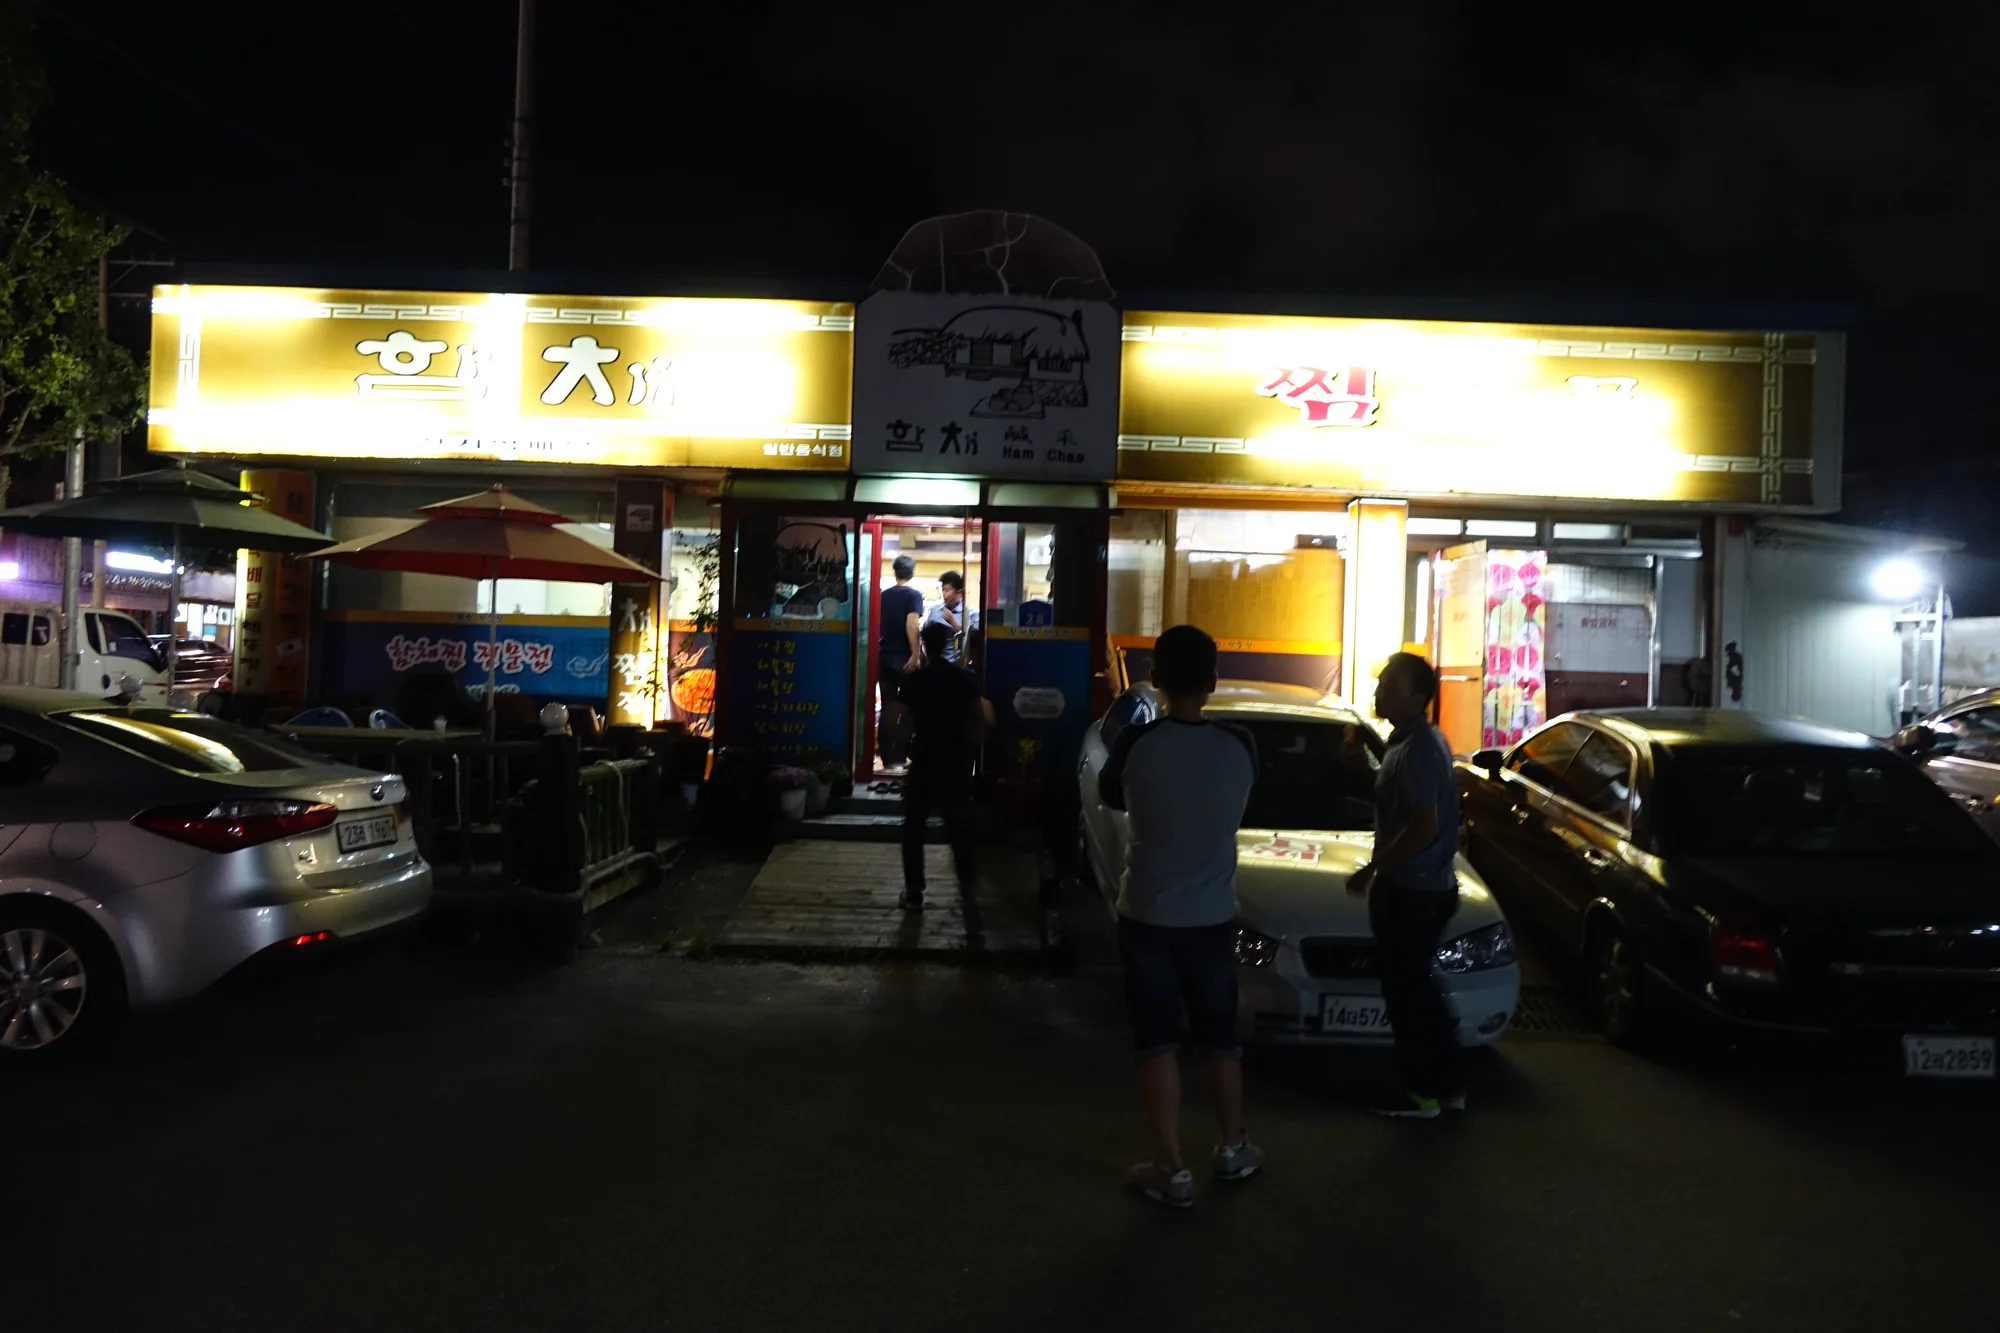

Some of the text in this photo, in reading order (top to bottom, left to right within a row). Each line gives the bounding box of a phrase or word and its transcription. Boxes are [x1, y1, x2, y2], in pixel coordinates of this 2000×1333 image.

[763, 442, 843, 458] 일반음식점
[1003, 447, 1034, 460] Ham
[1025, 614, 1045, 625] 28
[473, 639, 555, 675] 전문점
